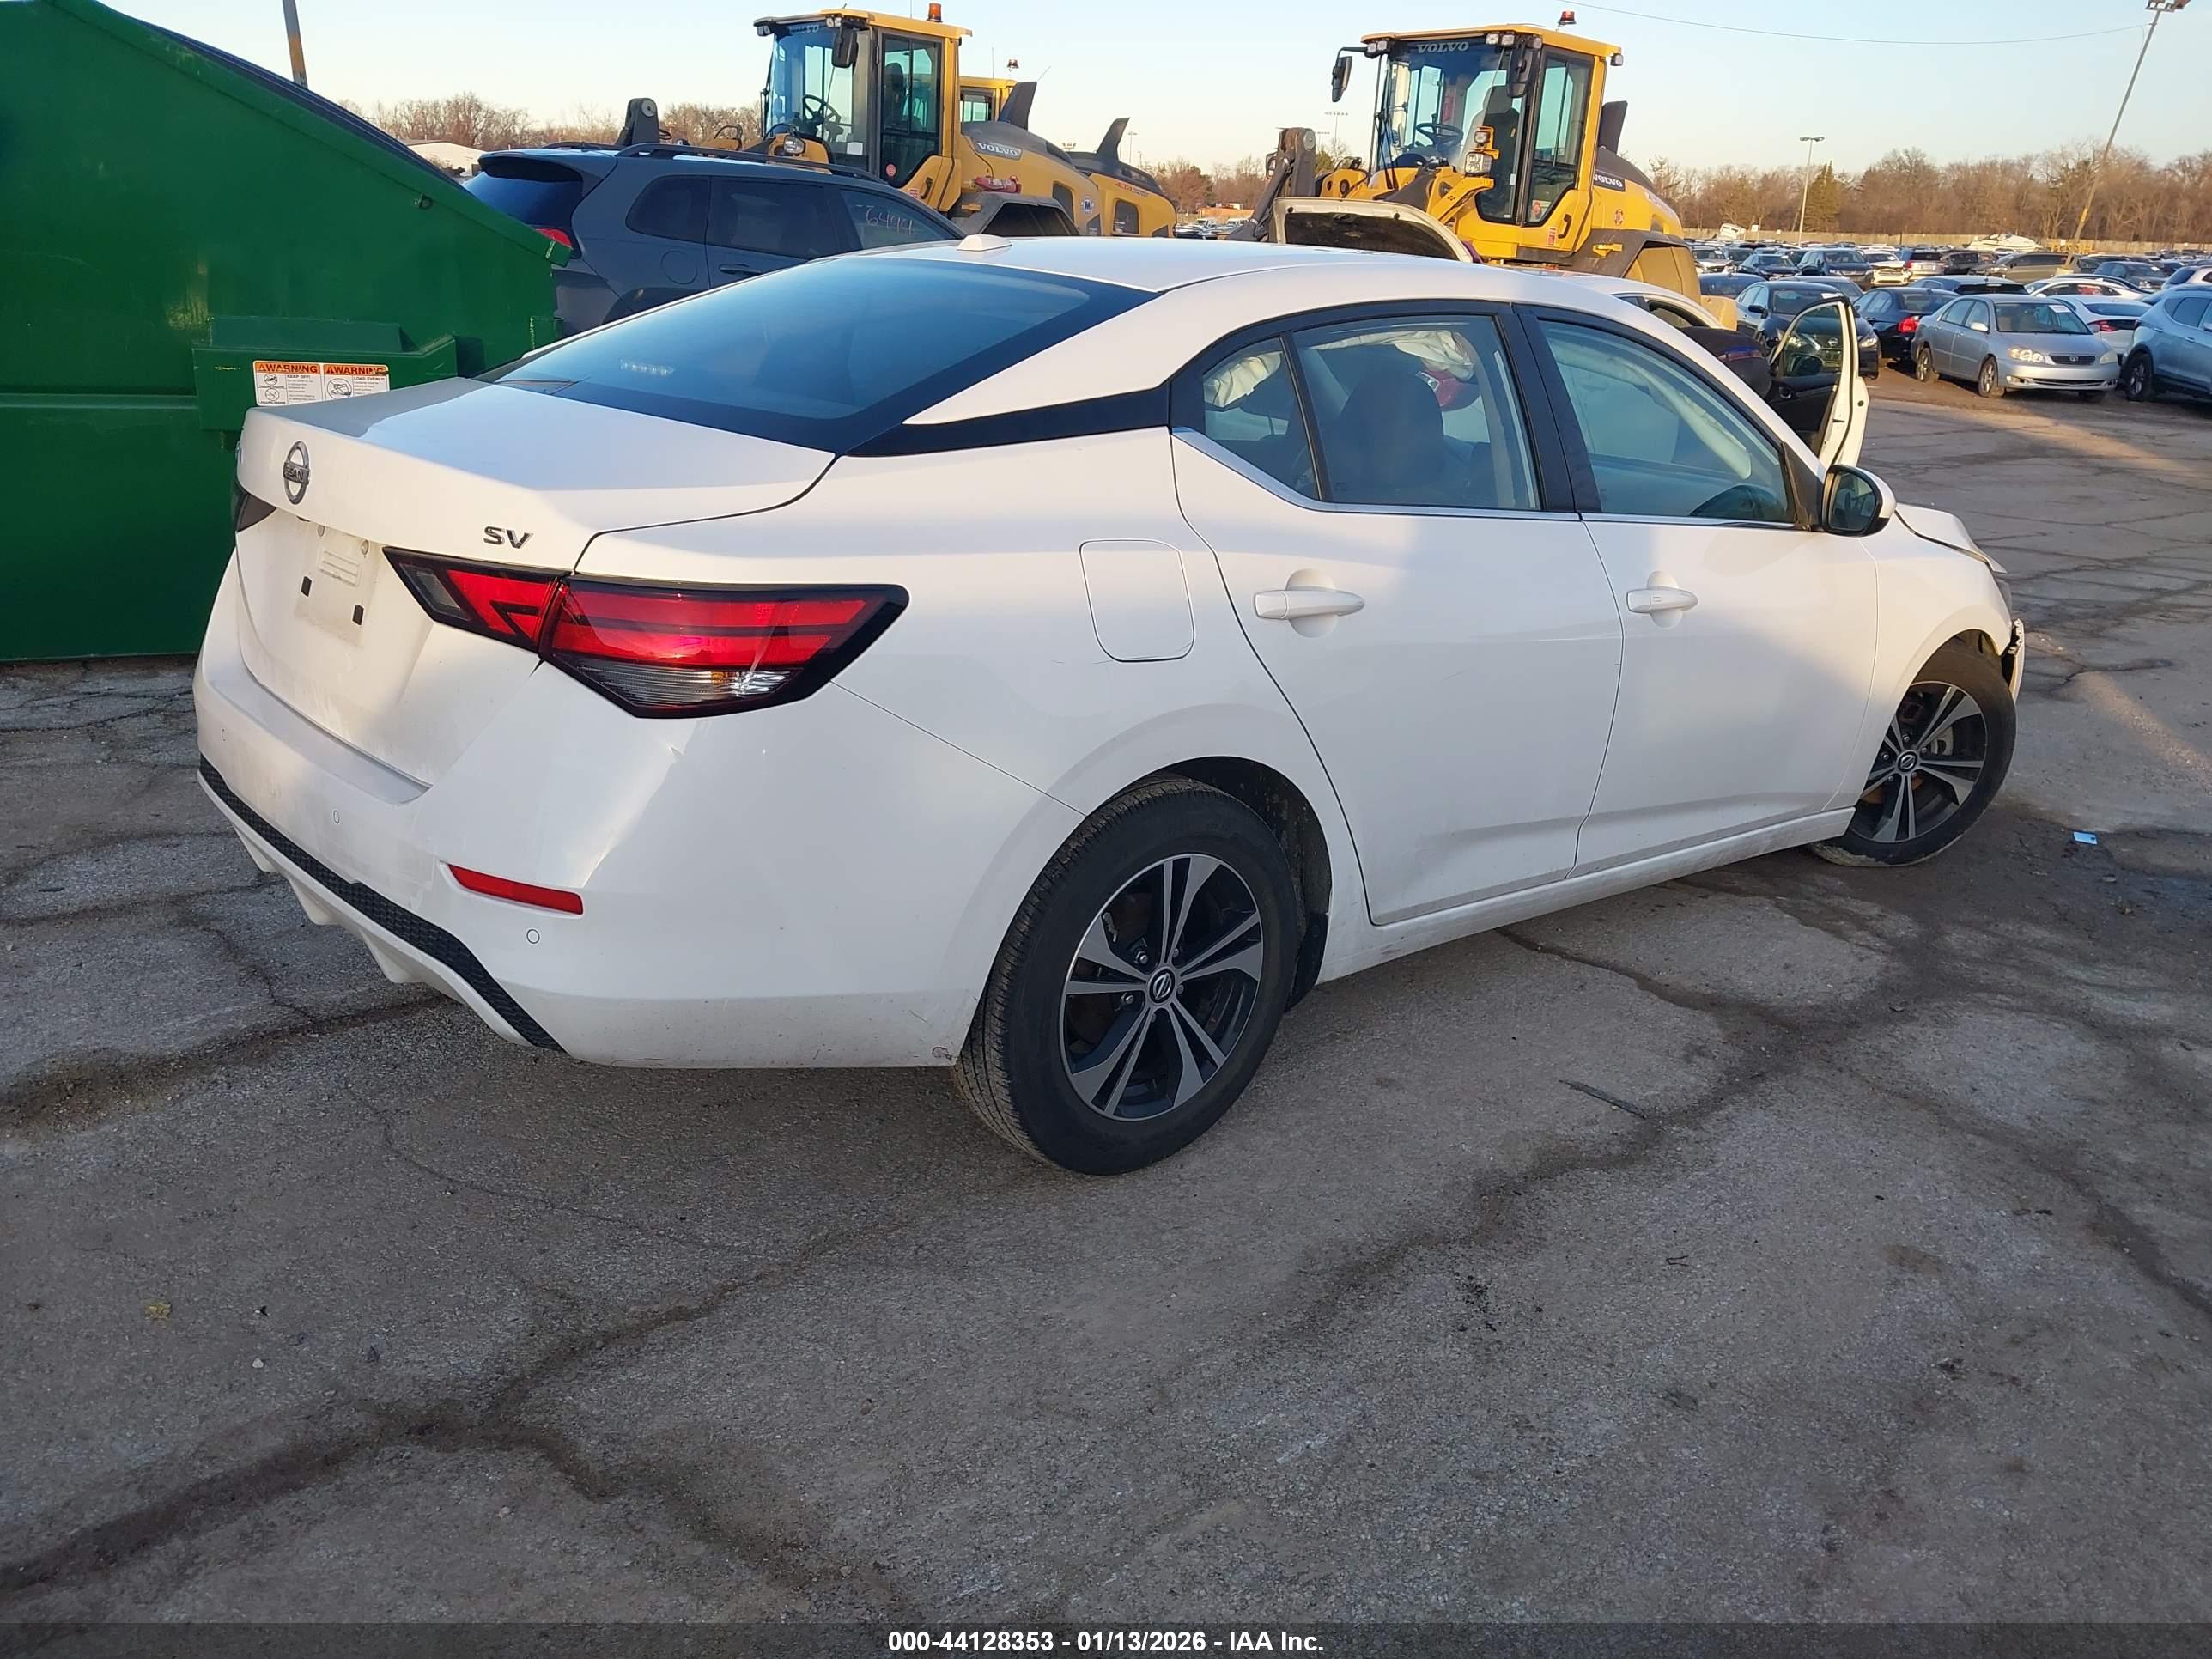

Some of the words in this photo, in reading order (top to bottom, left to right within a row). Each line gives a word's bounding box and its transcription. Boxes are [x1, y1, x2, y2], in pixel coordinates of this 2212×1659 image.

[1416, 41, 1469, 53] VOLVO
[975, 142, 1018, 156] VOLVO
[266, 363, 318, 374] WARNING
[483, 526, 533, 549] SV
